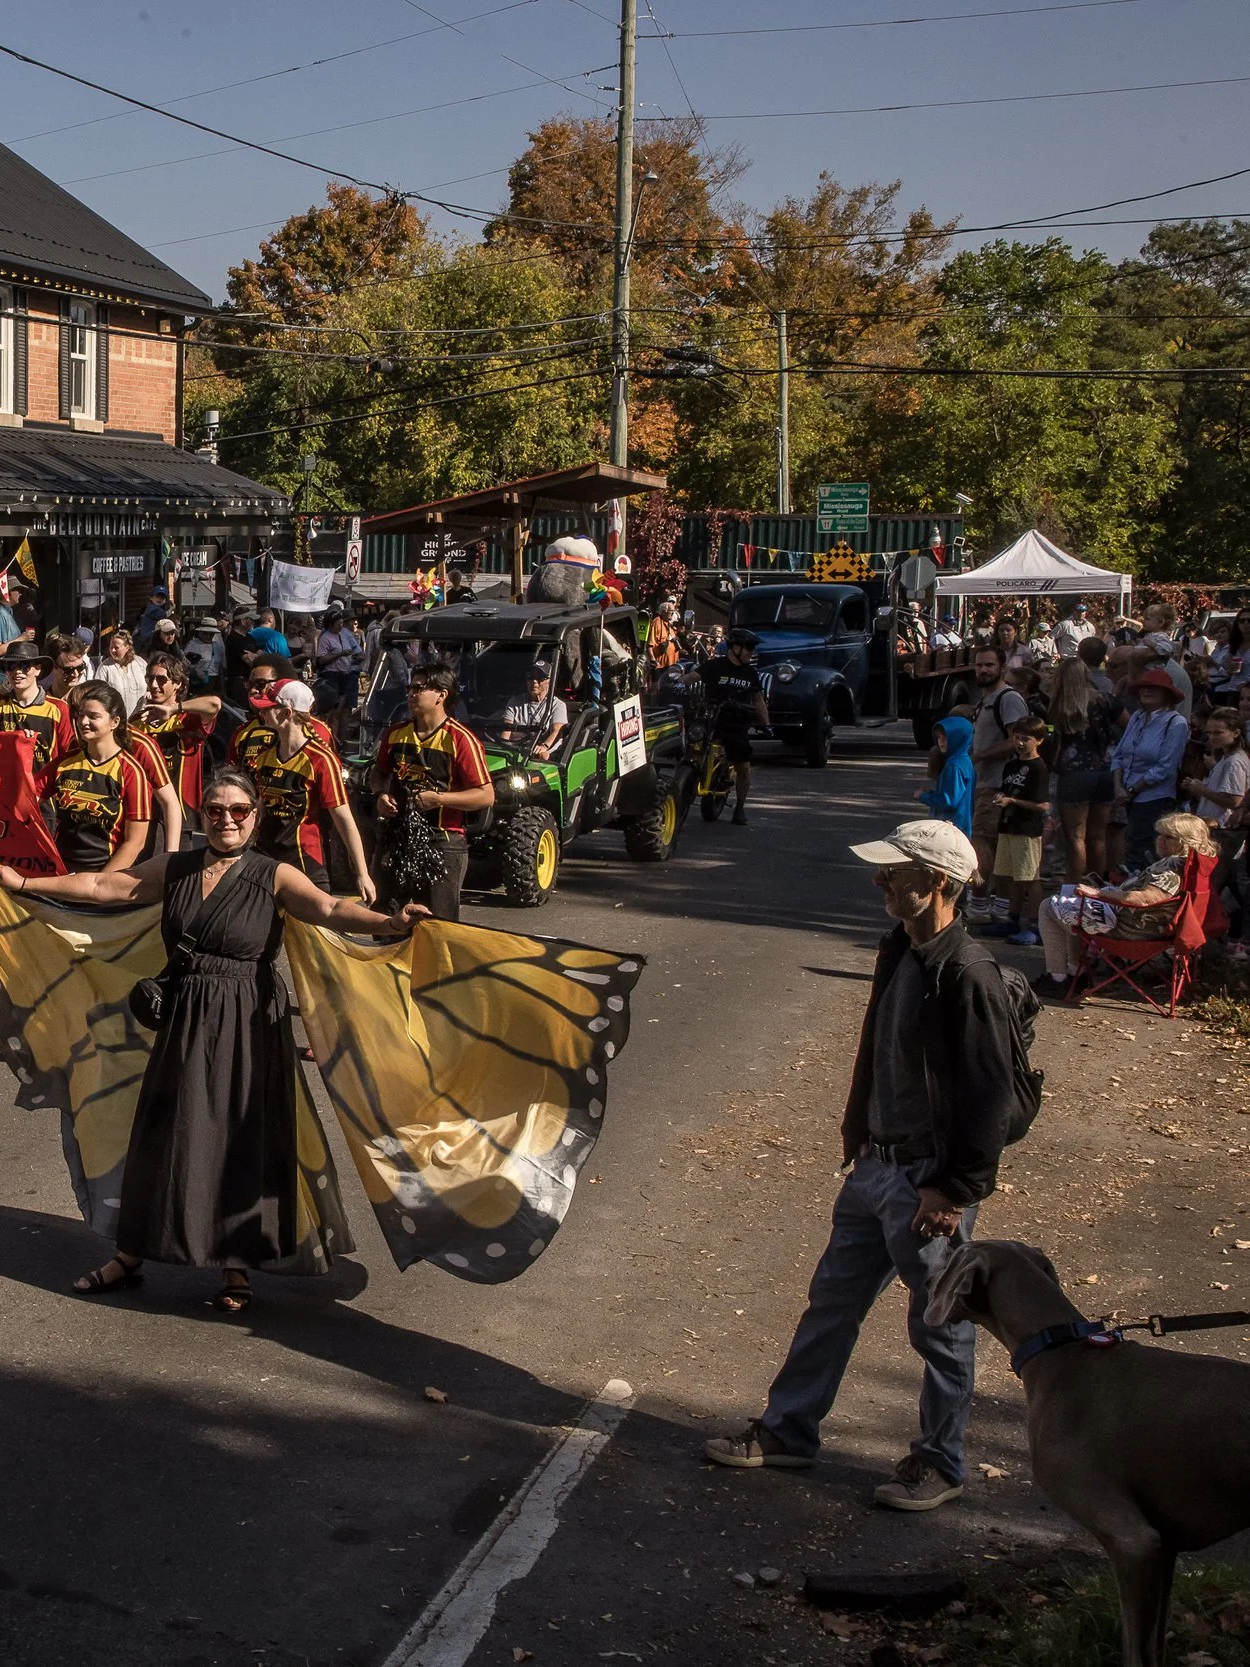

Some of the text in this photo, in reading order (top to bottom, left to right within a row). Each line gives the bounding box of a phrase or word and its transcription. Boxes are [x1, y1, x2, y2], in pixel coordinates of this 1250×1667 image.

[33, 518, 47, 530] THE
[50, 513, 140, 536] BELFOUNTAIN
[190, 551, 207, 566] CREAM
[421, 549, 467, 557] GRUND
[92, 557, 113, 573] COFFEE
[119, 555, 144, 572] PASTRIES
